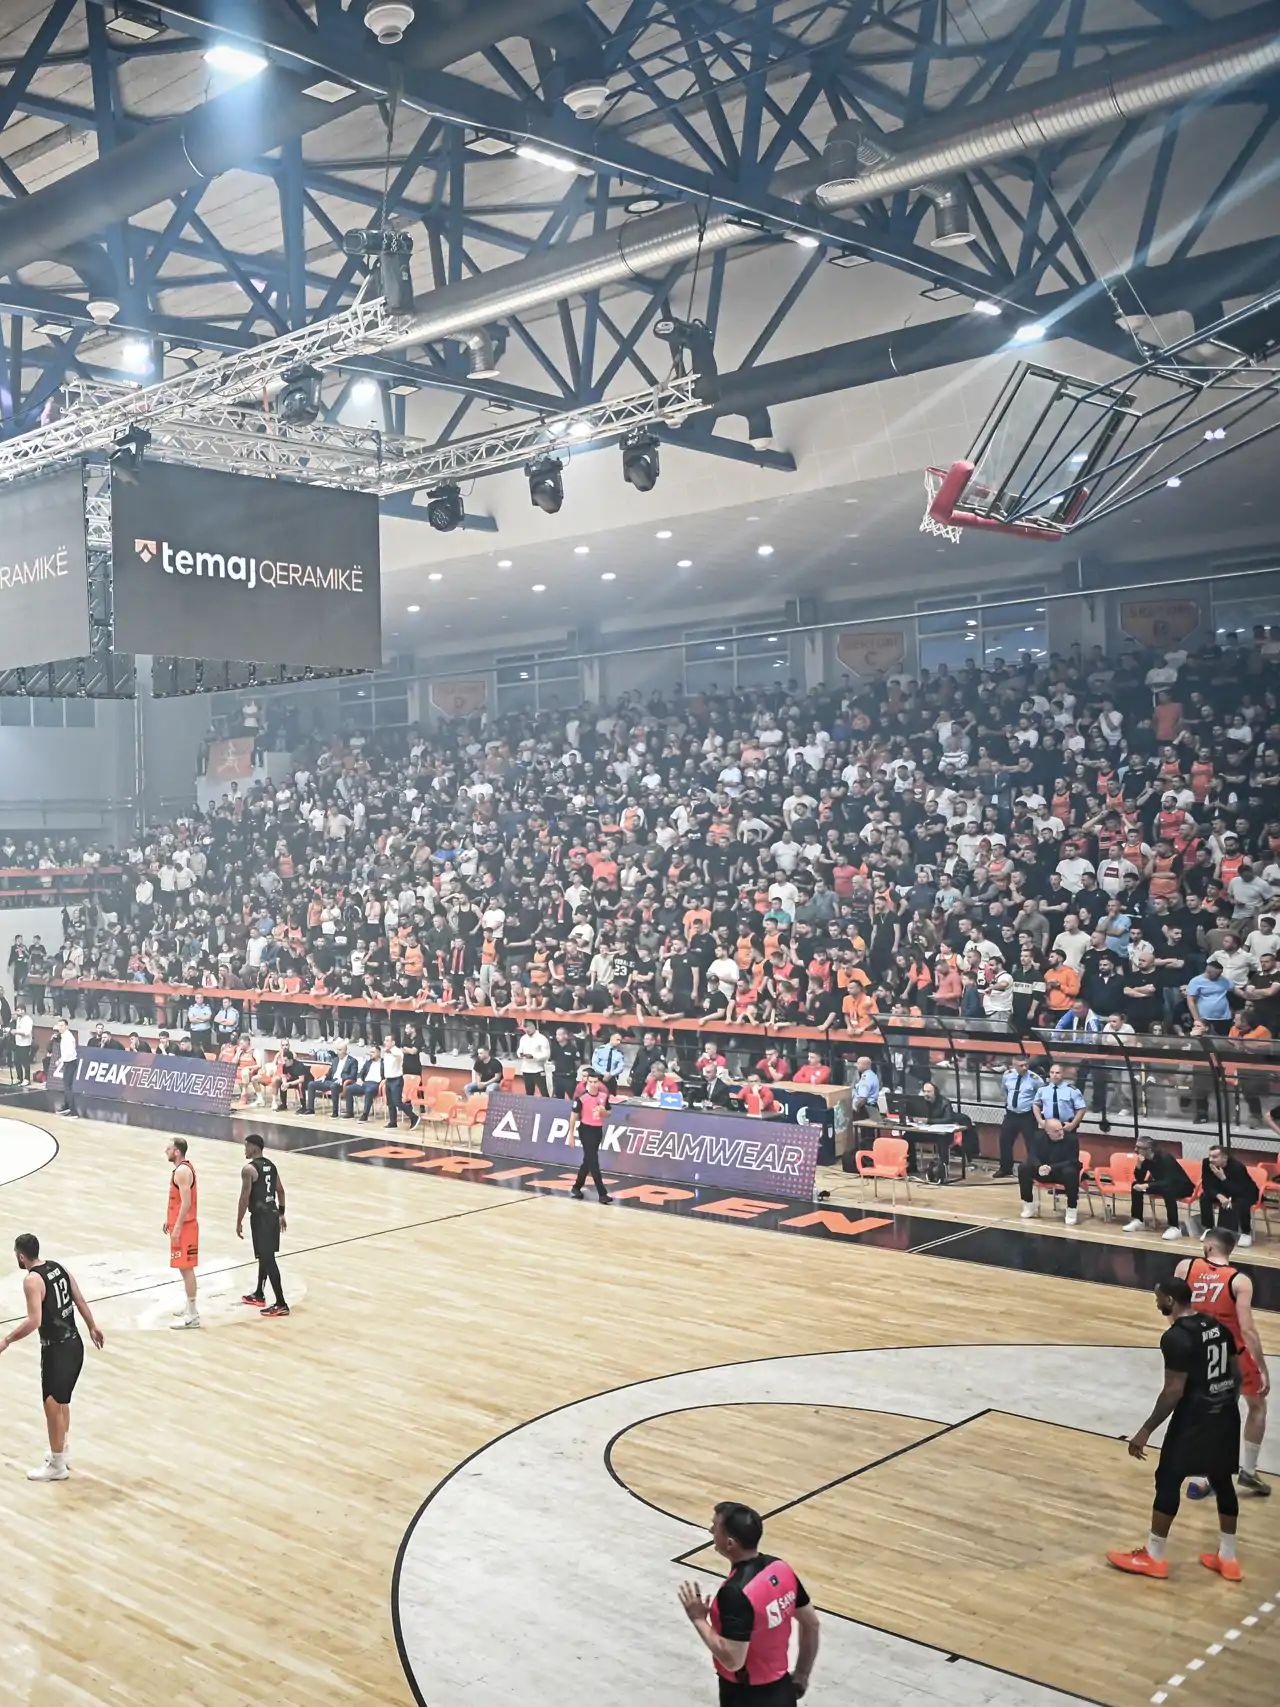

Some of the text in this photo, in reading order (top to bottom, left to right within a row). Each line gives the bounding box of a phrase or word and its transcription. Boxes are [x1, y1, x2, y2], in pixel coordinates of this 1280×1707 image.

[162, 541, 364, 592] temaj QERAMIKË
[83, 1053, 227, 1098] PEAK TEAMWEAR
[625, 1125, 804, 1176] TEAMWEAR
[348, 1146, 893, 1236] PRIZREN
[53, 1277, 70, 1309] 12
[1191, 1282, 1225, 1303] 27
[1207, 1341, 1228, 1380] 21
